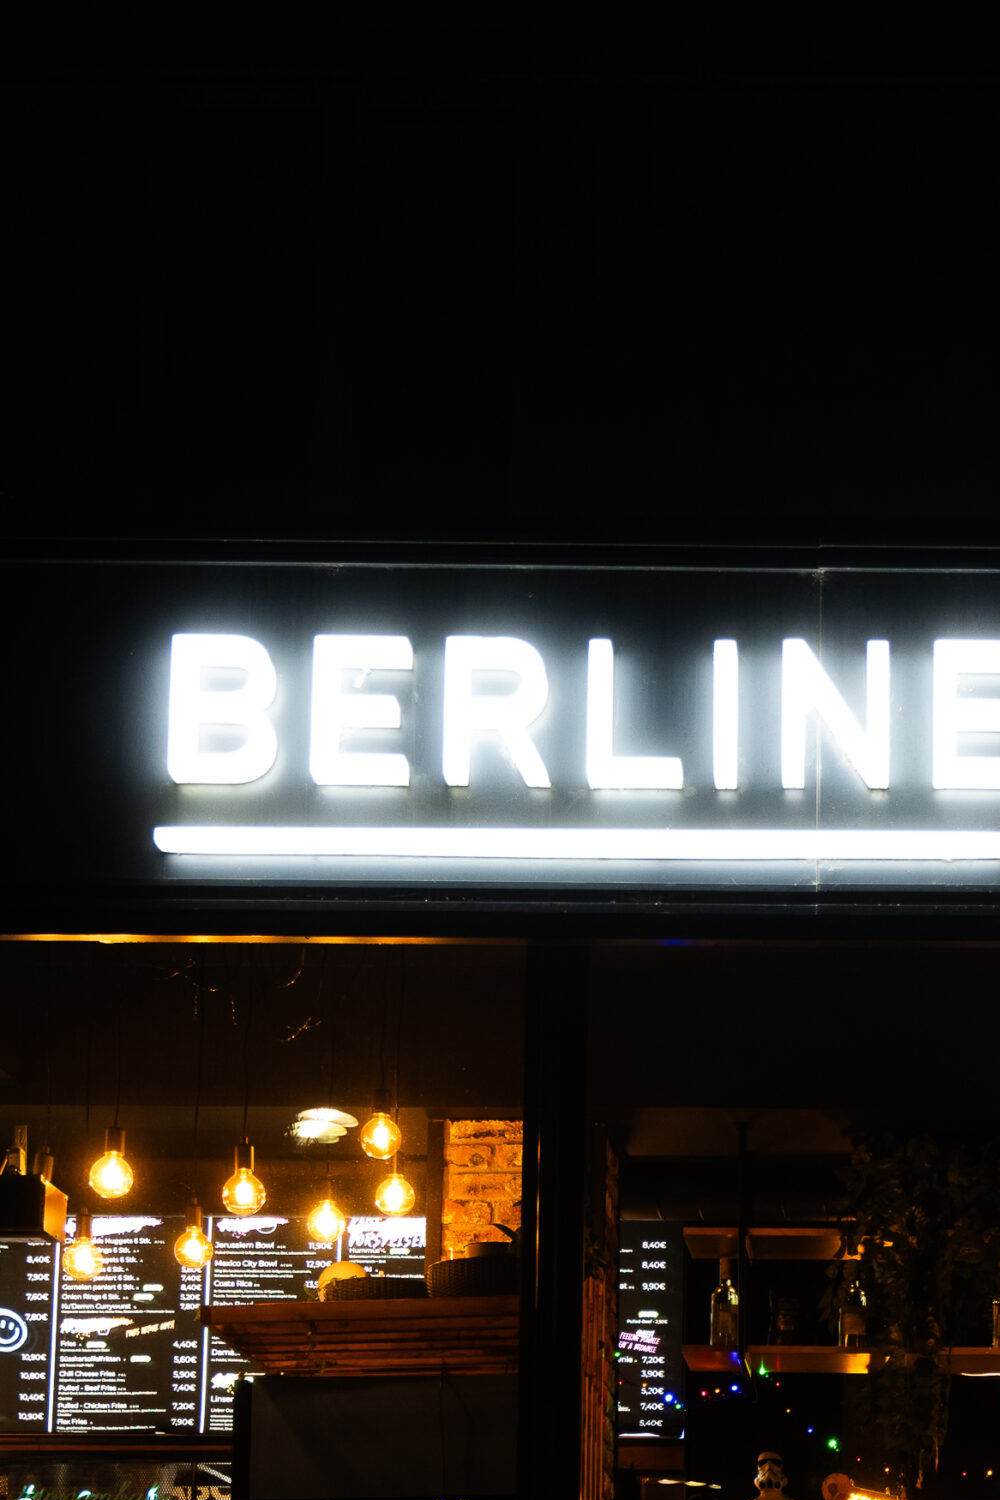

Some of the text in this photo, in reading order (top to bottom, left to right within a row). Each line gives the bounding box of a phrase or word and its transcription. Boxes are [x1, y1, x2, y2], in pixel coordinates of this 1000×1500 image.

[308, 1242, 333, 1250] 11,90€
[642, 1241, 667, 1249] 8,40€
[26, 1256, 51, 1264] 8,40€
[242, 1260, 258, 1268] City
[642, 1261, 666, 1270] 8,40€
[642, 1282, 666, 1291] 9,90€
[641, 1356, 665, 1364] 7,20€
[20, 1372, 46, 1380] 10,80€
[641, 1370, 665, 1378] 3,90€
[172, 1384, 197, 1392] 7,40€
[641, 1387, 664, 1395] 5,20€
[19, 1393, 45, 1401] 10,40€
[640, 1403, 664, 1411] 7,40€
[18, 1412, 44, 1420] 10,90€
[171, 1418, 195, 1426] 7,90€
[639, 1420, 663, 1428] 5,40€
